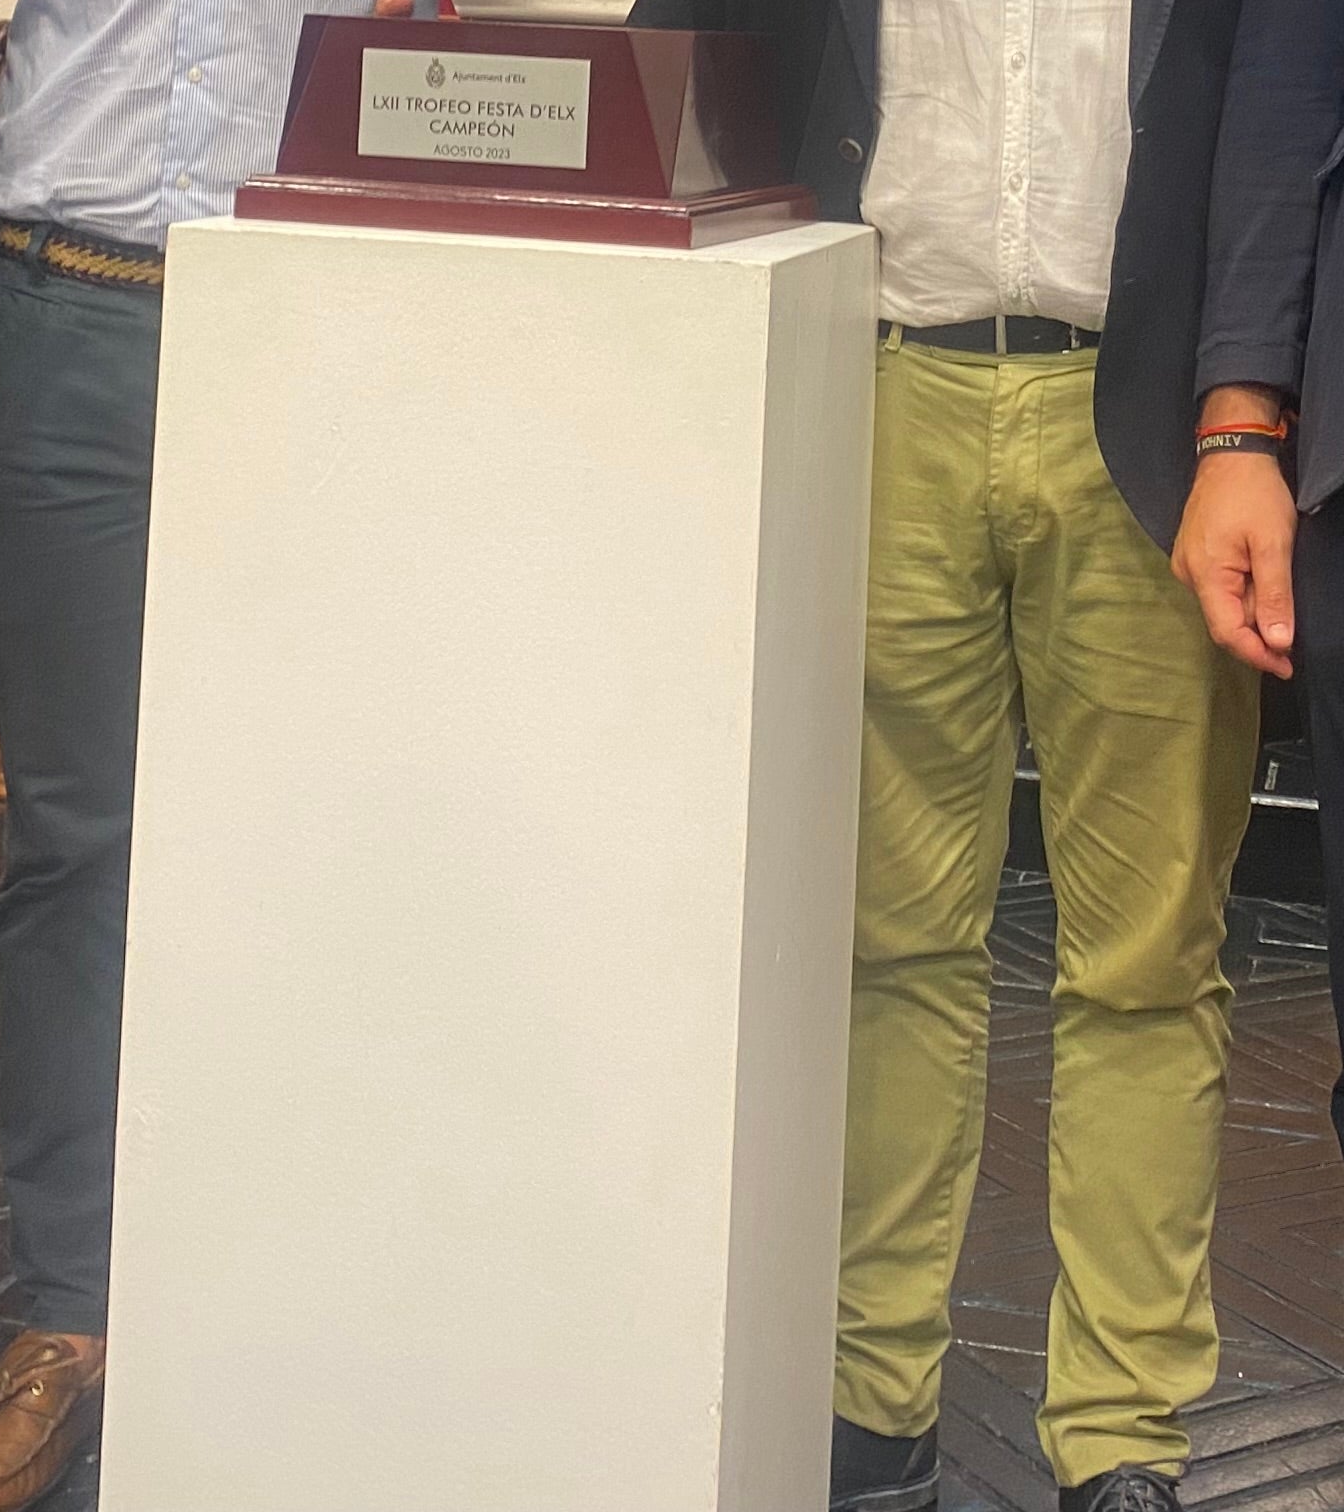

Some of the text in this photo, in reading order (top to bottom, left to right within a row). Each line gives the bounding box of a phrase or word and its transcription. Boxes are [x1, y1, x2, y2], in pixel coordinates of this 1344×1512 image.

[452, 71, 503, 84] Ajuntament
[372, 94, 576, 121] LXII TROFEO FESTA D'ELX
[429, 118, 515, 139] CAMPEÓN
[432, 144, 511, 160] AGOSTO 2023
